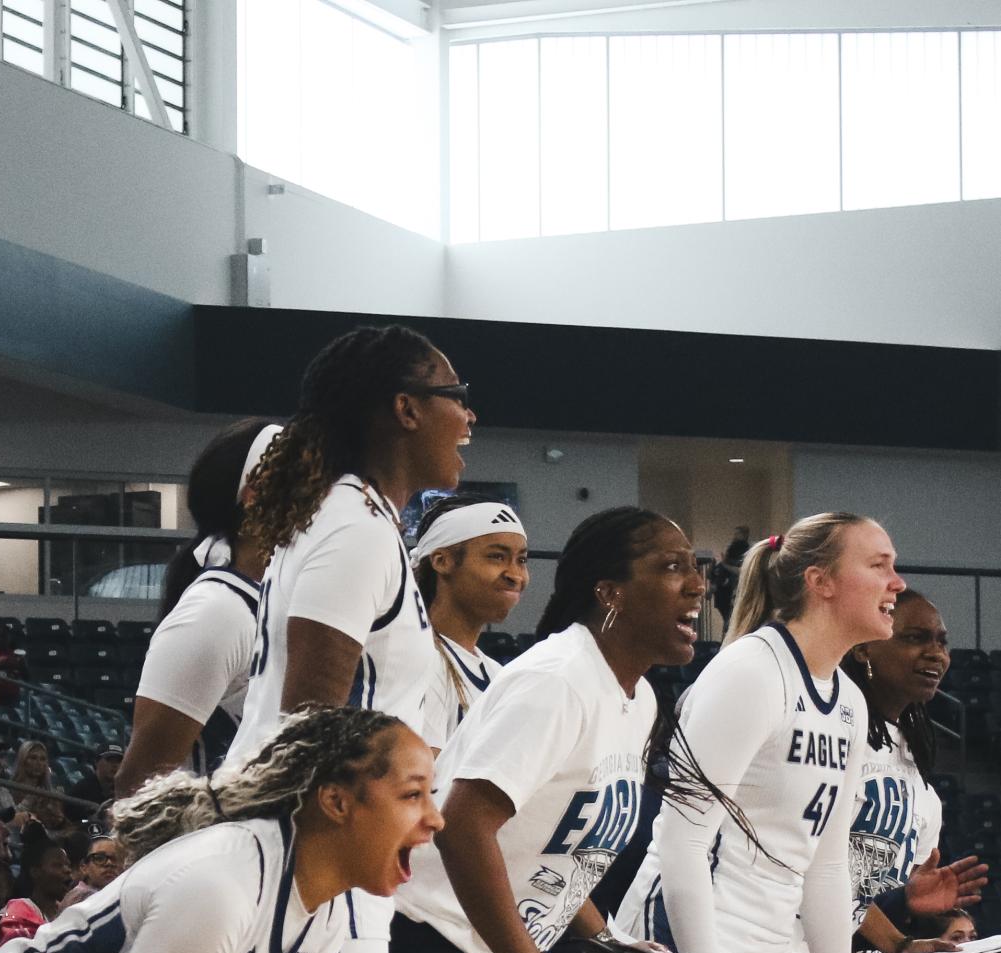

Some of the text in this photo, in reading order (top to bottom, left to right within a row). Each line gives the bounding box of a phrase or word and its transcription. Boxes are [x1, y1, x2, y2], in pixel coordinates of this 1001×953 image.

[787, 730, 850, 770] EAGLE
[541, 779, 639, 855] EAGL
[802, 783, 838, 837] 41
